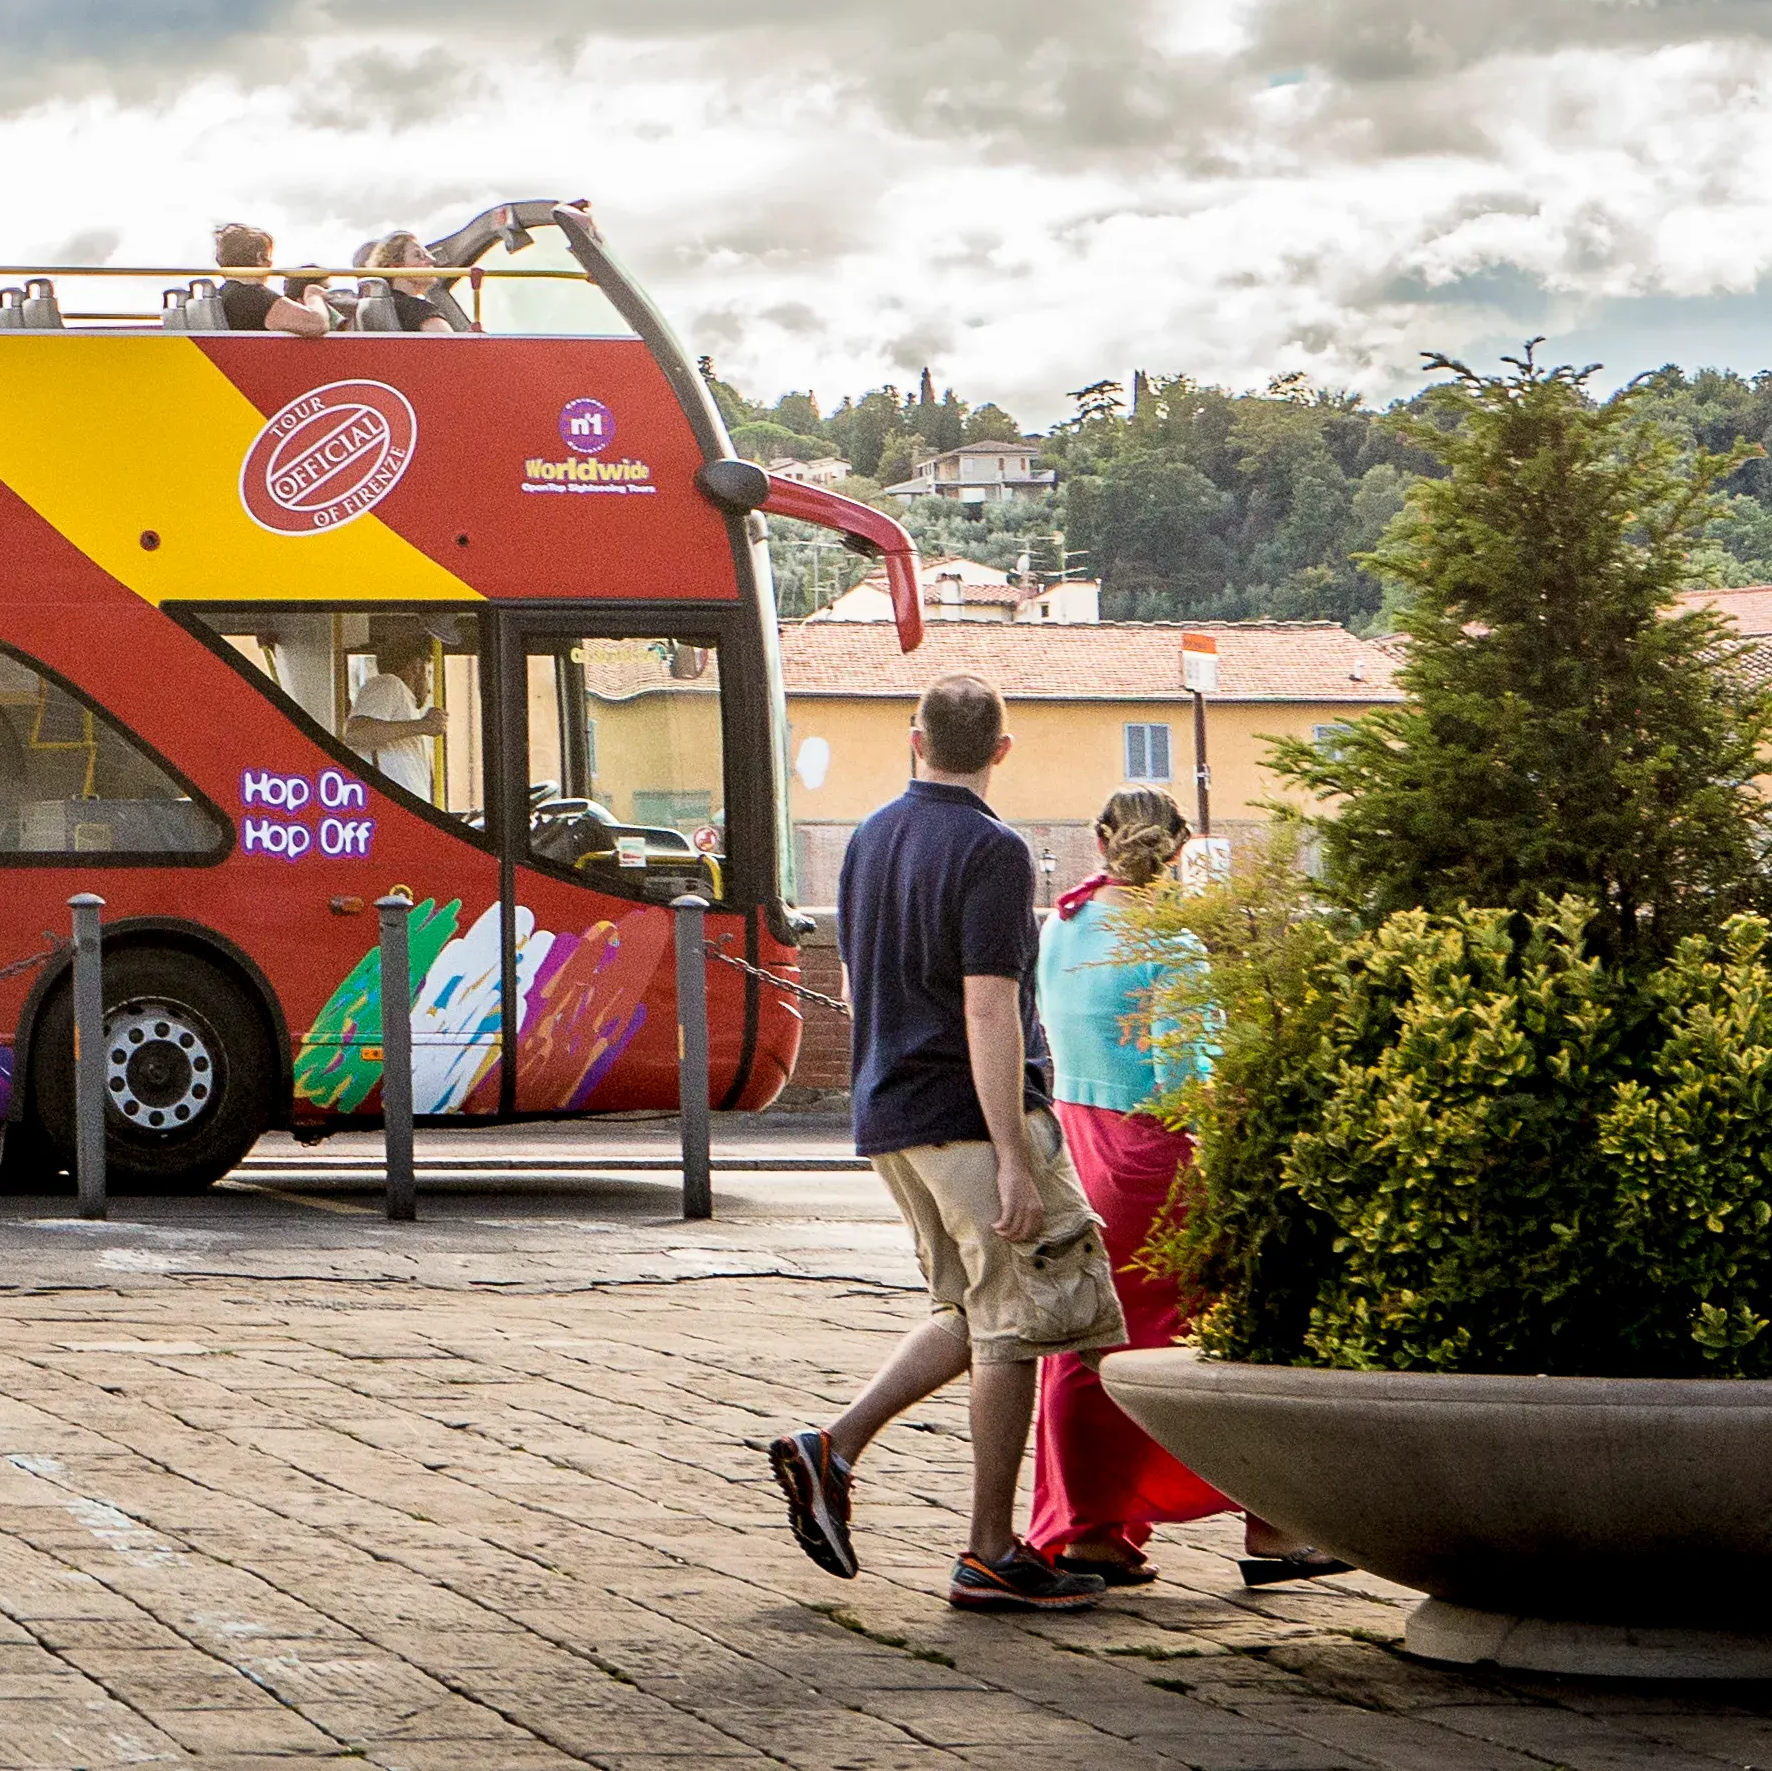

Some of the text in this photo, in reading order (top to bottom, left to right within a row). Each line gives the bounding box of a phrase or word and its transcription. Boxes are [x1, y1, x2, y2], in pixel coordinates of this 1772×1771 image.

[269, 395, 326, 439] TOUR
[274, 414, 385, 501] OFFICIAL
[524, 457, 650, 481] Worldwide
[313, 445, 407, 529] OF FIRENZE
[243, 770, 364, 811] Hop On
[243, 818, 373, 858] Hop Off
